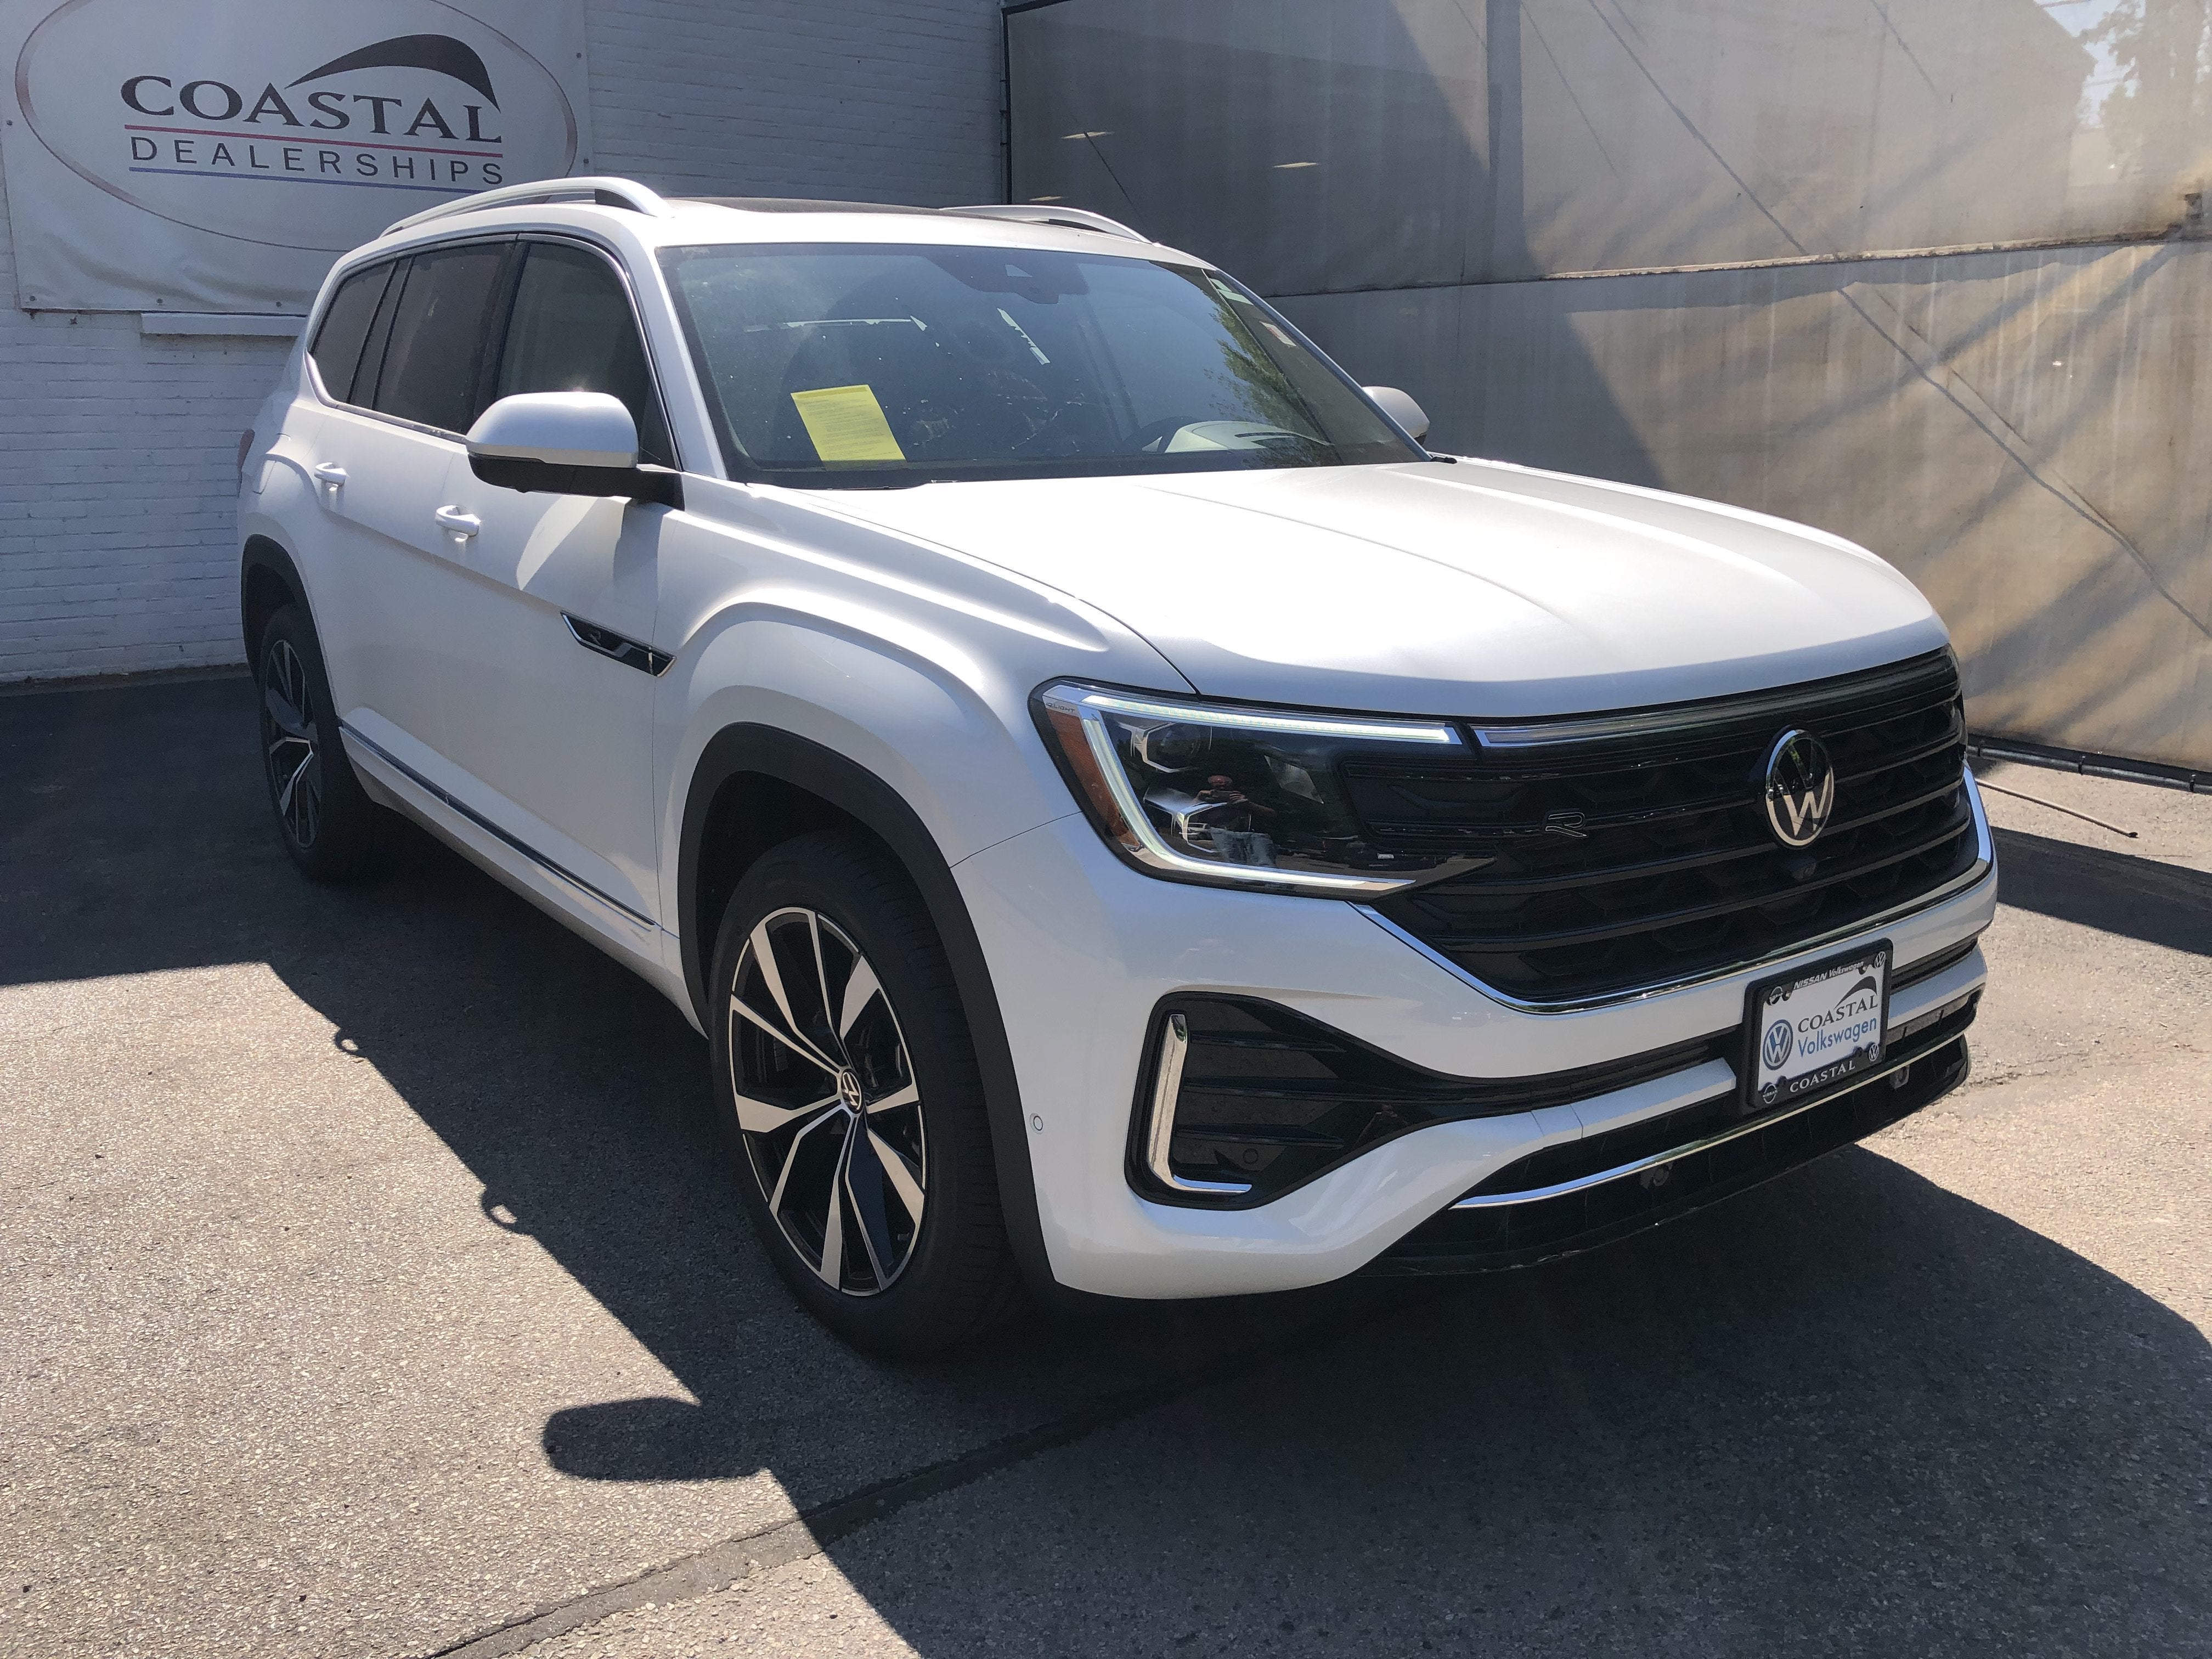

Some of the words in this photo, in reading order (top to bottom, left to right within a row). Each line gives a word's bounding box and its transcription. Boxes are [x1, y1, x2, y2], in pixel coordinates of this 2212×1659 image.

[121, 75, 502, 144] COASTAL
[131, 136, 503, 185] DEALERSHIPS
[1794, 972, 1828, 990] NISSAN
[1829, 961, 1864, 978] Volkswagen
[1797, 995, 1878, 1033] COASTAL
[1797, 1017, 1877, 1058] Volkswagen
[1790, 1060, 1855, 1093] COASTAL
